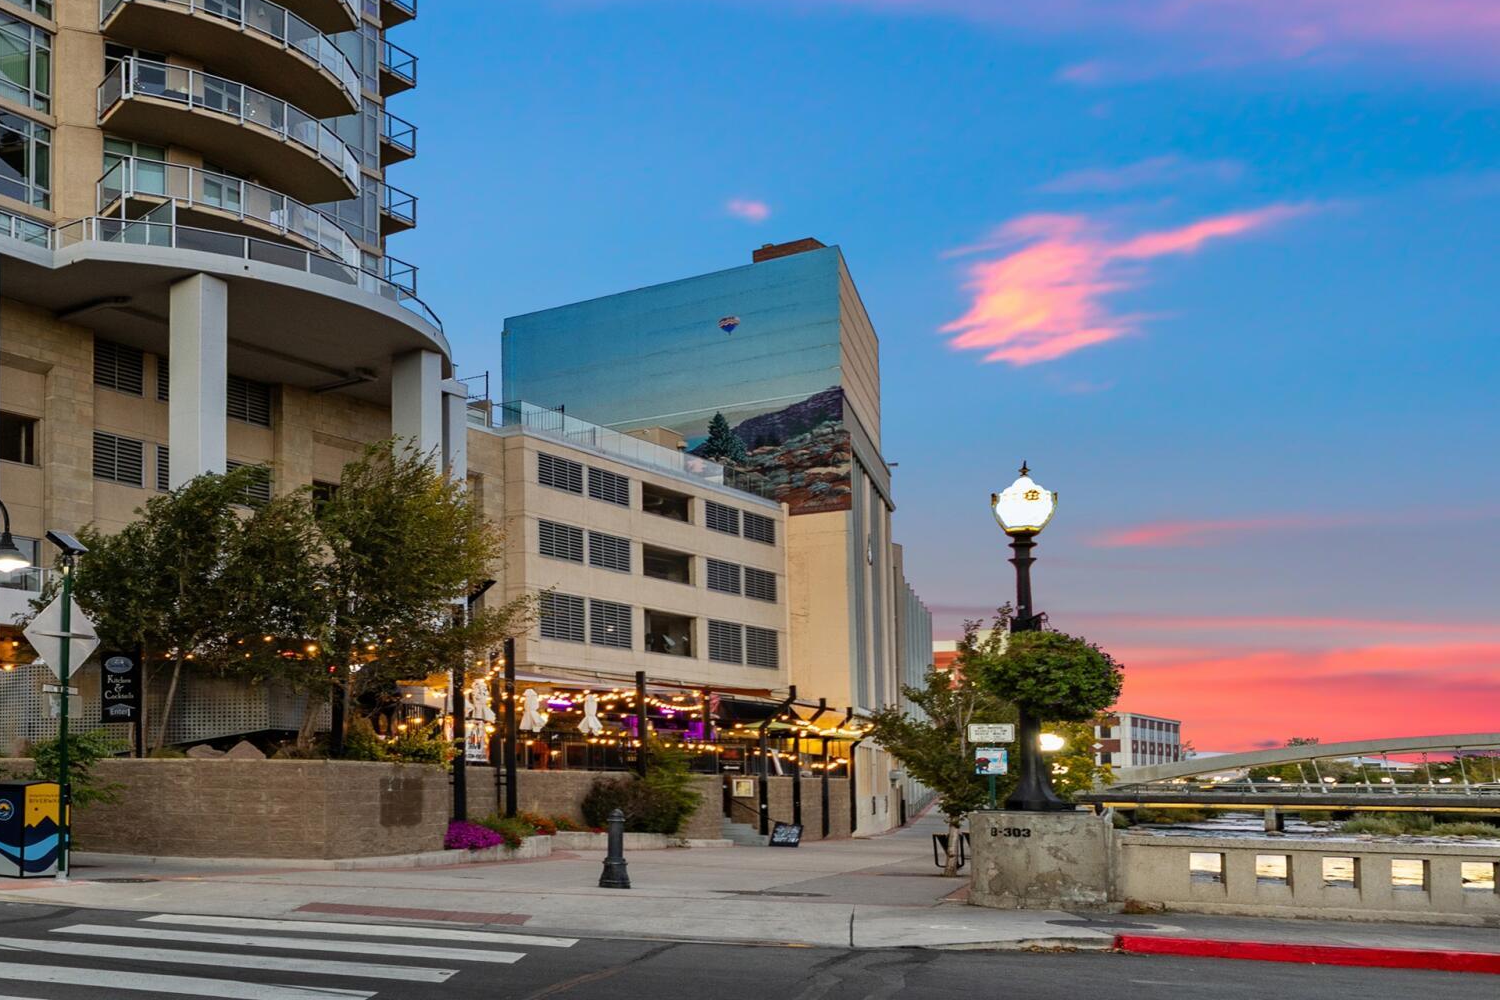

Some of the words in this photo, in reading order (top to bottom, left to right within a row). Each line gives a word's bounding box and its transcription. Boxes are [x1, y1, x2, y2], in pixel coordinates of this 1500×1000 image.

[107, 674, 132, 684] Kitchen
[114, 684, 124, 692] &
[104, 690, 134, 699] Cocktails
[990, 827, 1031, 838] B-303
